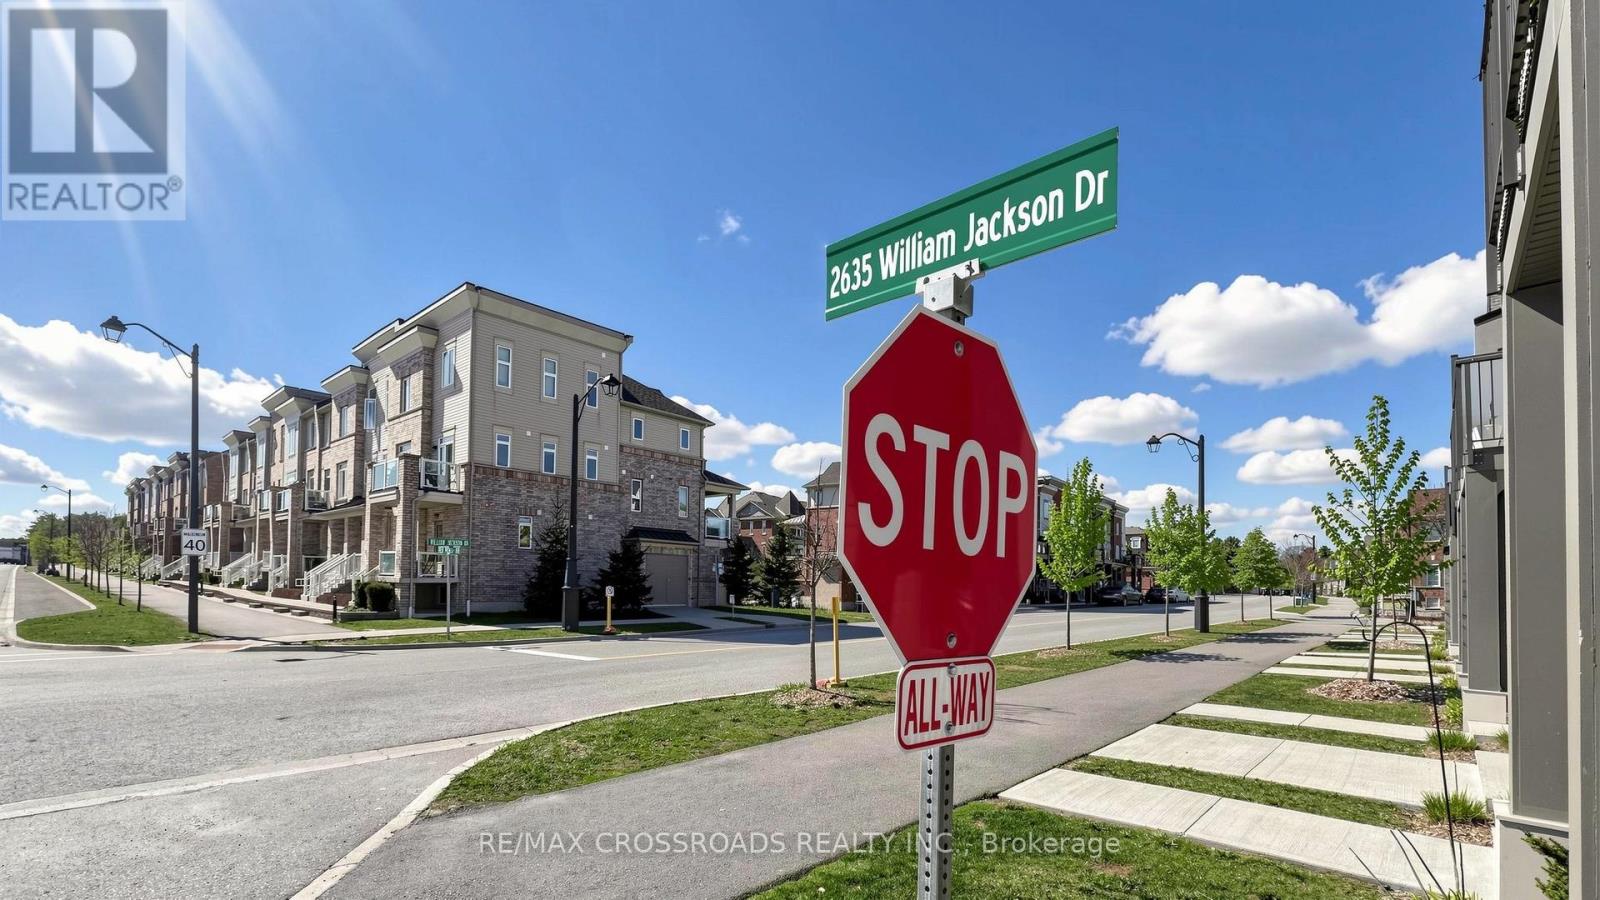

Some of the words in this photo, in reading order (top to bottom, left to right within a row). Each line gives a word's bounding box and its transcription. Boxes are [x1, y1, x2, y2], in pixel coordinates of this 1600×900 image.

[829, 252, 873, 299] 2635
[879, 228, 956, 280] William
[963, 188, 1064, 252] Jackson
[1075, 169, 1109, 213] Dr
[858, 413, 1029, 558] STOP
[184, 540, 206, 551] 40
[904, 671, 990, 736] ALL-WAY
